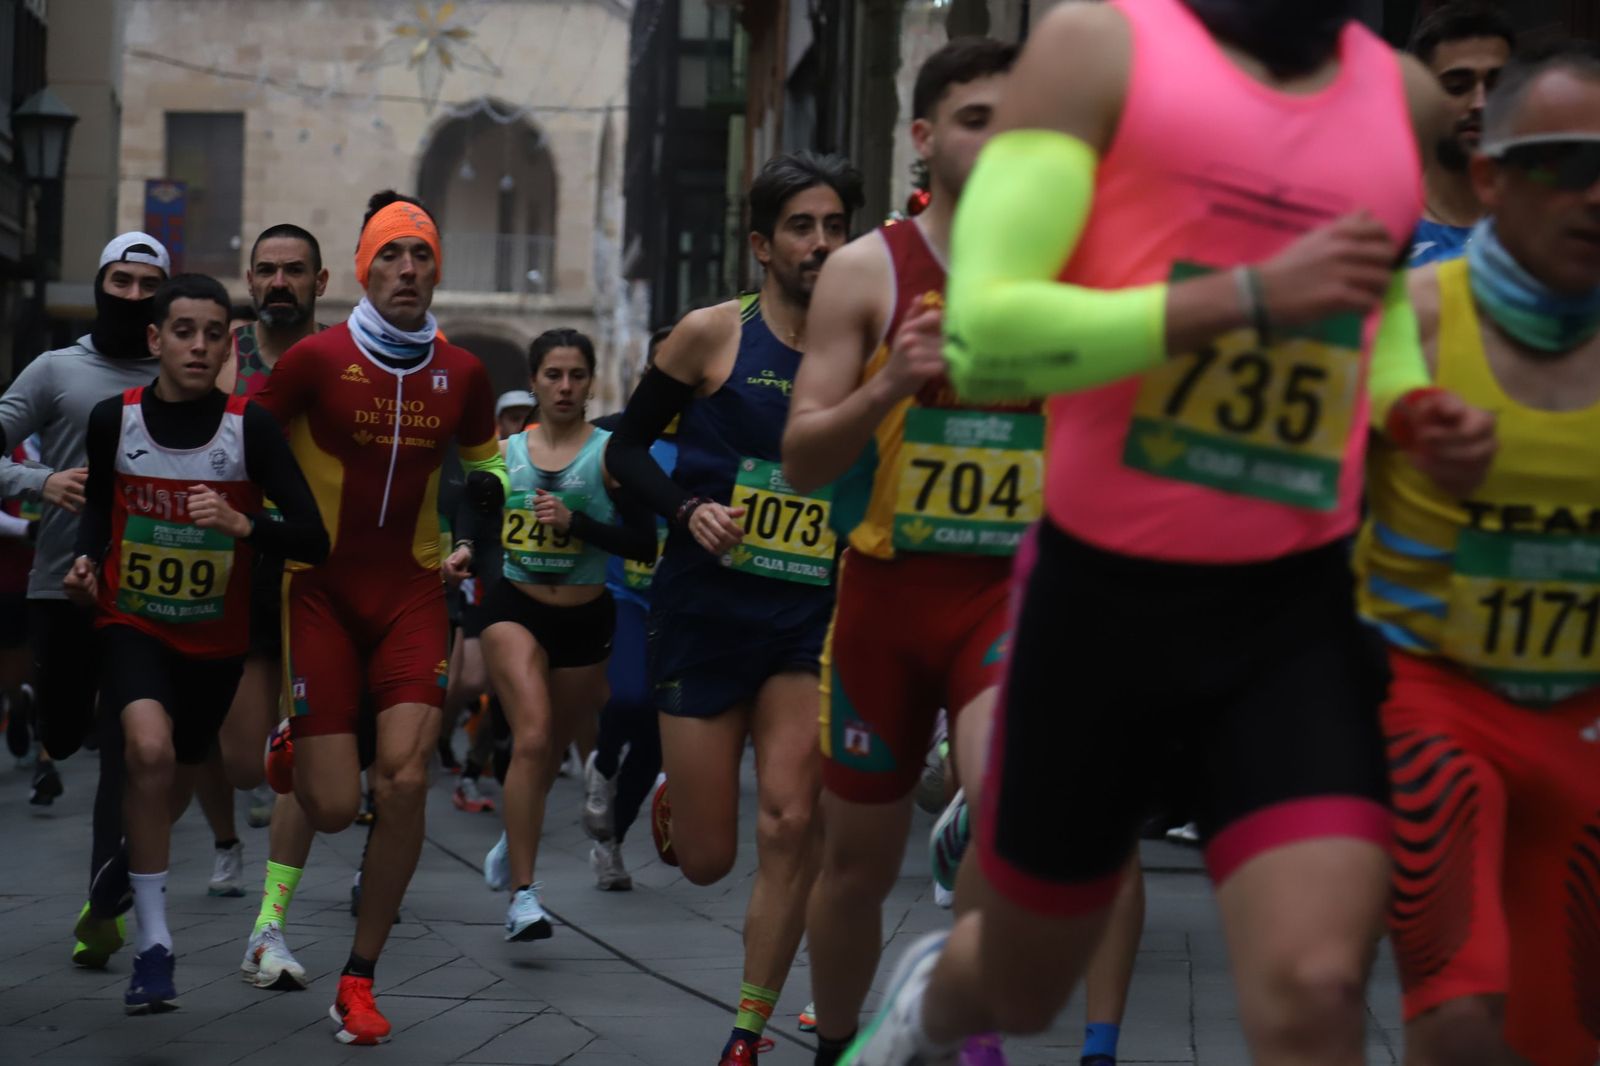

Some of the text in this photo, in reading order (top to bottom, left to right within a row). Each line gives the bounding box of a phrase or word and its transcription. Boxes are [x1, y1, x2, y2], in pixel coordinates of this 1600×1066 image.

[373, 397, 425, 413] VINO
[1165, 345, 1327, 445] 735
[354, 410, 441, 429] DE TORO
[911, 458, 1022, 517] 704
[742, 493, 823, 546] 1073
[127, 552, 214, 597] 599
[753, 555, 784, 571] CAJA
[147, 602, 217, 616] CAJA RURAL
[1480, 587, 1600, 658] 1171
